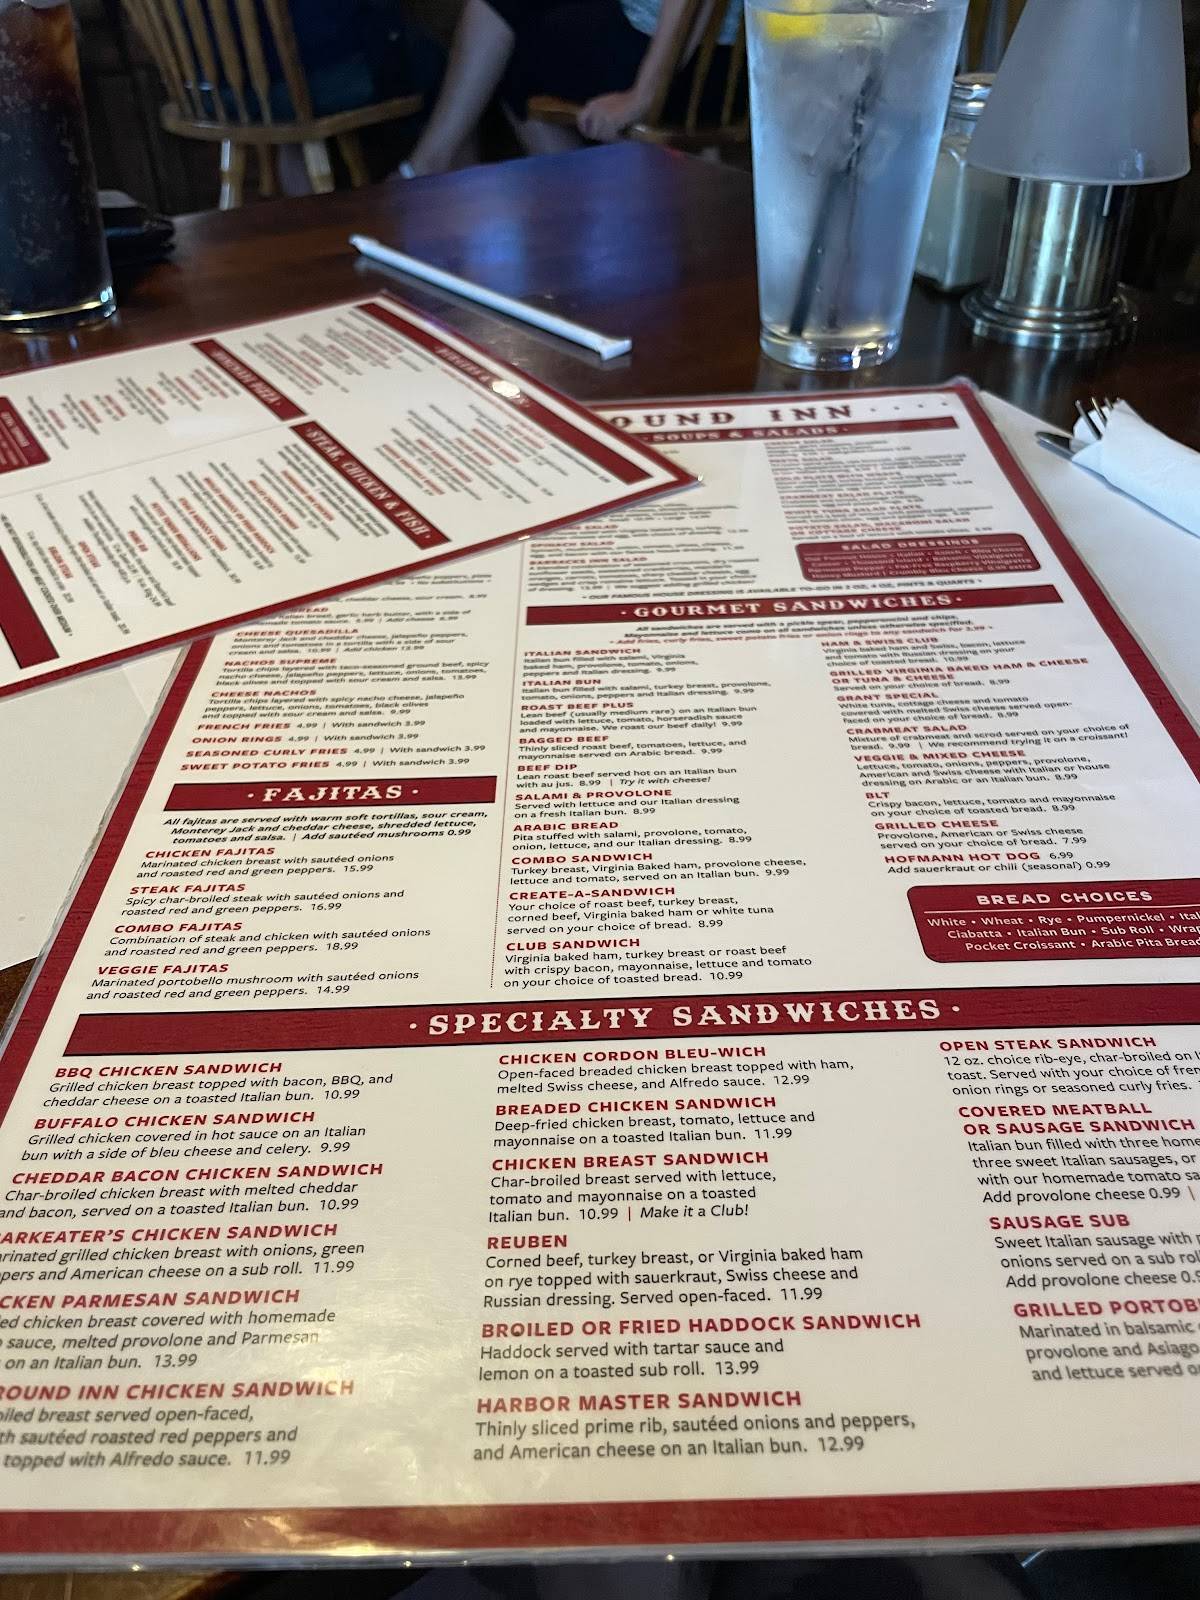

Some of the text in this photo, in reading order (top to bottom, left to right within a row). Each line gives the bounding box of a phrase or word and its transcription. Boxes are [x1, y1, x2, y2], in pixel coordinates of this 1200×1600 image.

[770, 405, 850, 421] INN
[653, 426, 837, 441] SOUPS & SALADS
[305, 428, 431, 535] STEAK, CHICKEN & FISH
[897, 538, 978, 547] DRESSINGS
[633, 595, 951, 617] GOURMET SANDWICHES
[846, 724, 966, 734] CRABMEAT SALAD
[519, 736, 572, 744] BAGGED
[972, 750, 1025, 758] CHEESE
[262, 785, 401, 801] FAJITAS
[586, 789, 671, 798] PROVOLONE
[513, 821, 618, 831] ARABIC BREAD
[874, 819, 998, 829] GRILLED CHEESE
[145, 847, 275, 858] CHICKEN FAJITAS
[511, 853, 652, 864] COMBO SANDWICH
[884, 851, 1073, 863] HOFMANN HOT DOG 6.99
[140, 859, 198, 868] Marinated
[200, 858, 242, 866] chicken
[245, 857, 281, 868] breast
[311, 855, 354, 863] sautéed
[357, 854, 393, 863] onions
[887, 865, 910, 873] Add
[994, 863, 1017, 871] chili
[1021, 861, 1082, 872] (seasonal)
[1085, 860, 1110, 868] 0.99
[129, 883, 245, 894] STEAK FAJITAS
[509, 887, 674, 900] CREATE-A-SANDWICH
[976, 891, 1152, 904] BREAD CHOICES
[927, 912, 1165, 926] White Wheat Rye Pumpernickel
[114, 922, 242, 933] COMBO FAJITAS
[506, 938, 639, 951] CLUB SANDWICH
[98, 963, 228, 974] VEGGIE FAJITAS
[429, 999, 940, 1035] SPECIALTY SANDWICHES
[939, 1037, 1156, 1051] OPEN STEAK SANDWICH
[499, 1046, 765, 1064] CHICKEN CORDON BLEU-WICH
[55, 1062, 282, 1078] BBQ CHICKEN SANDWICH
[34, 1111, 314, 1129] BUFFALO CHICKEN SANDWICH
[12, 1163, 383, 1184] CHEDDAR BACON CHICKEN SANDWICH
[489, 1203, 748, 1222] Italian bun. 10.99 Make it a Club!
[989, 1214, 1130, 1229] SAUSAGE SUB
[131, 1227, 220, 1241] CHICKEN
[226, 1223, 337, 1239] SANDWICH
[487, 1234, 567, 1249] REUBEN
[1013, 1298, 1200, 1317] GRILLED PORTOB
[482, 1314, 920, 1338] BROILED OR FRIED HADDOCK SANDWICH
[477, 1390, 801, 1413] HARBOR MASTER SANDWICH
[475, 1412, 915, 1440] Thinly sliced prime rib, sautéed onions and peppers,
